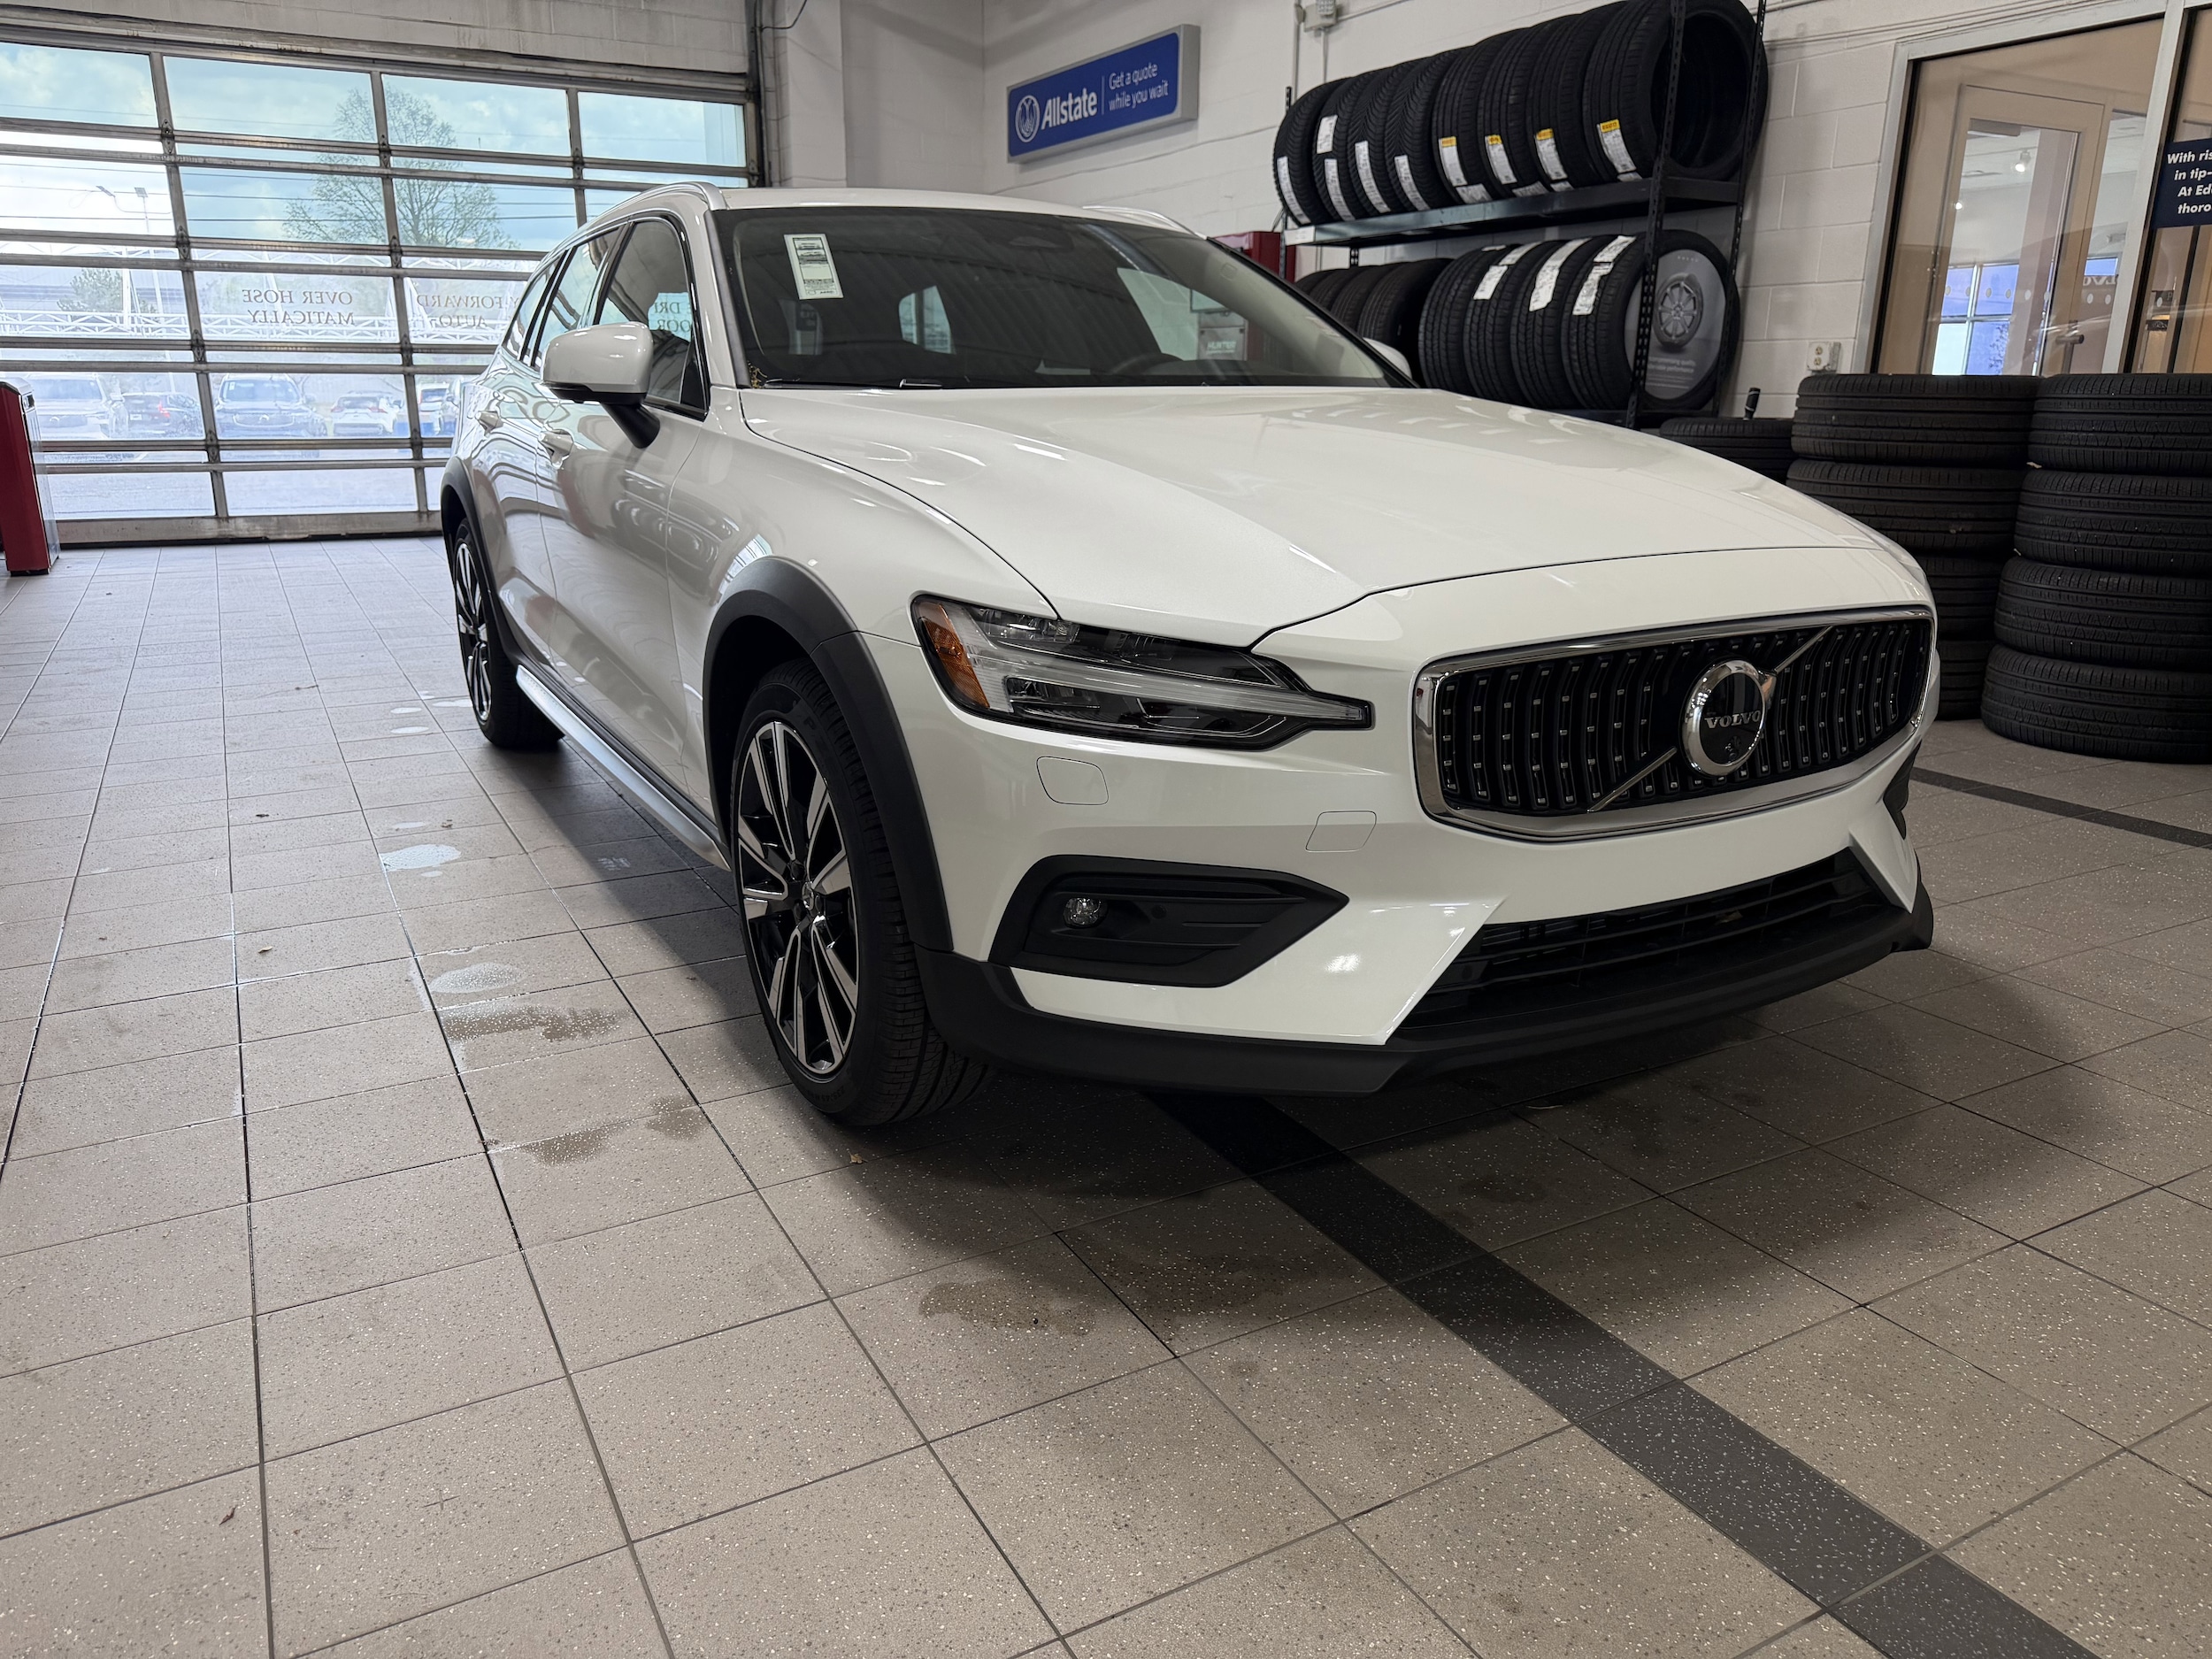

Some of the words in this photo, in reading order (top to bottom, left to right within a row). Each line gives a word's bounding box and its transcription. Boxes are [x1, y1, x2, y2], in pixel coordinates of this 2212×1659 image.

[1108, 72, 1125, 90] Get
[1125, 73, 1133, 86] a
[1132, 62, 1158, 88] quote
[1108, 91, 1132, 111] while
[1131, 89, 1148, 109] you
[1148, 80, 1169, 99] wait
[1041, 88, 1098, 130] Allstate
[2167, 150, 2196, 165] With
[2174, 169, 2187, 180] in
[2177, 186, 2193, 197] At
[2195, 183, 2212, 196] Ed
[2177, 203, 2212, 214] thoro
[1704, 710, 1762, 729] VOLVO
